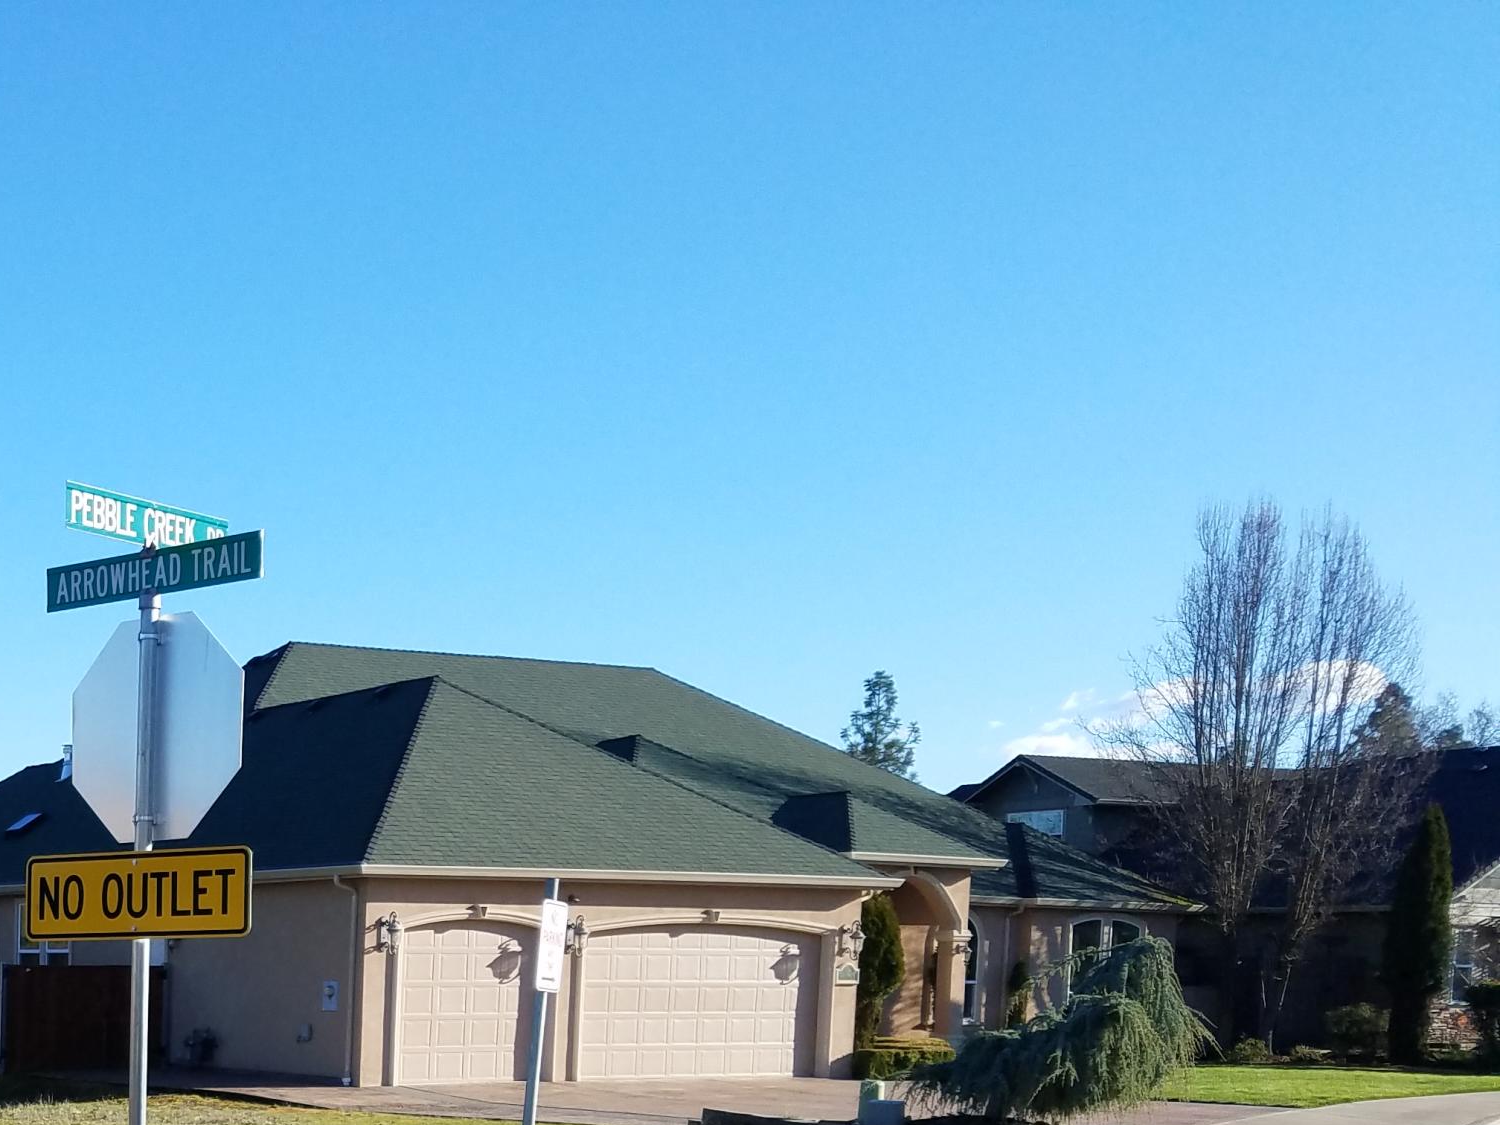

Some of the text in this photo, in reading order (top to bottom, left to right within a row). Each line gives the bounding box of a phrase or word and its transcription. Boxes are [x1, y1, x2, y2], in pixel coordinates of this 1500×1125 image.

[70, 489, 137, 537] PEBBLE
[143, 507, 196, 545] CREEK
[56, 540, 252, 605] ARROWHEAD TRAIL
[39, 868, 236, 920] NO OUTLET
